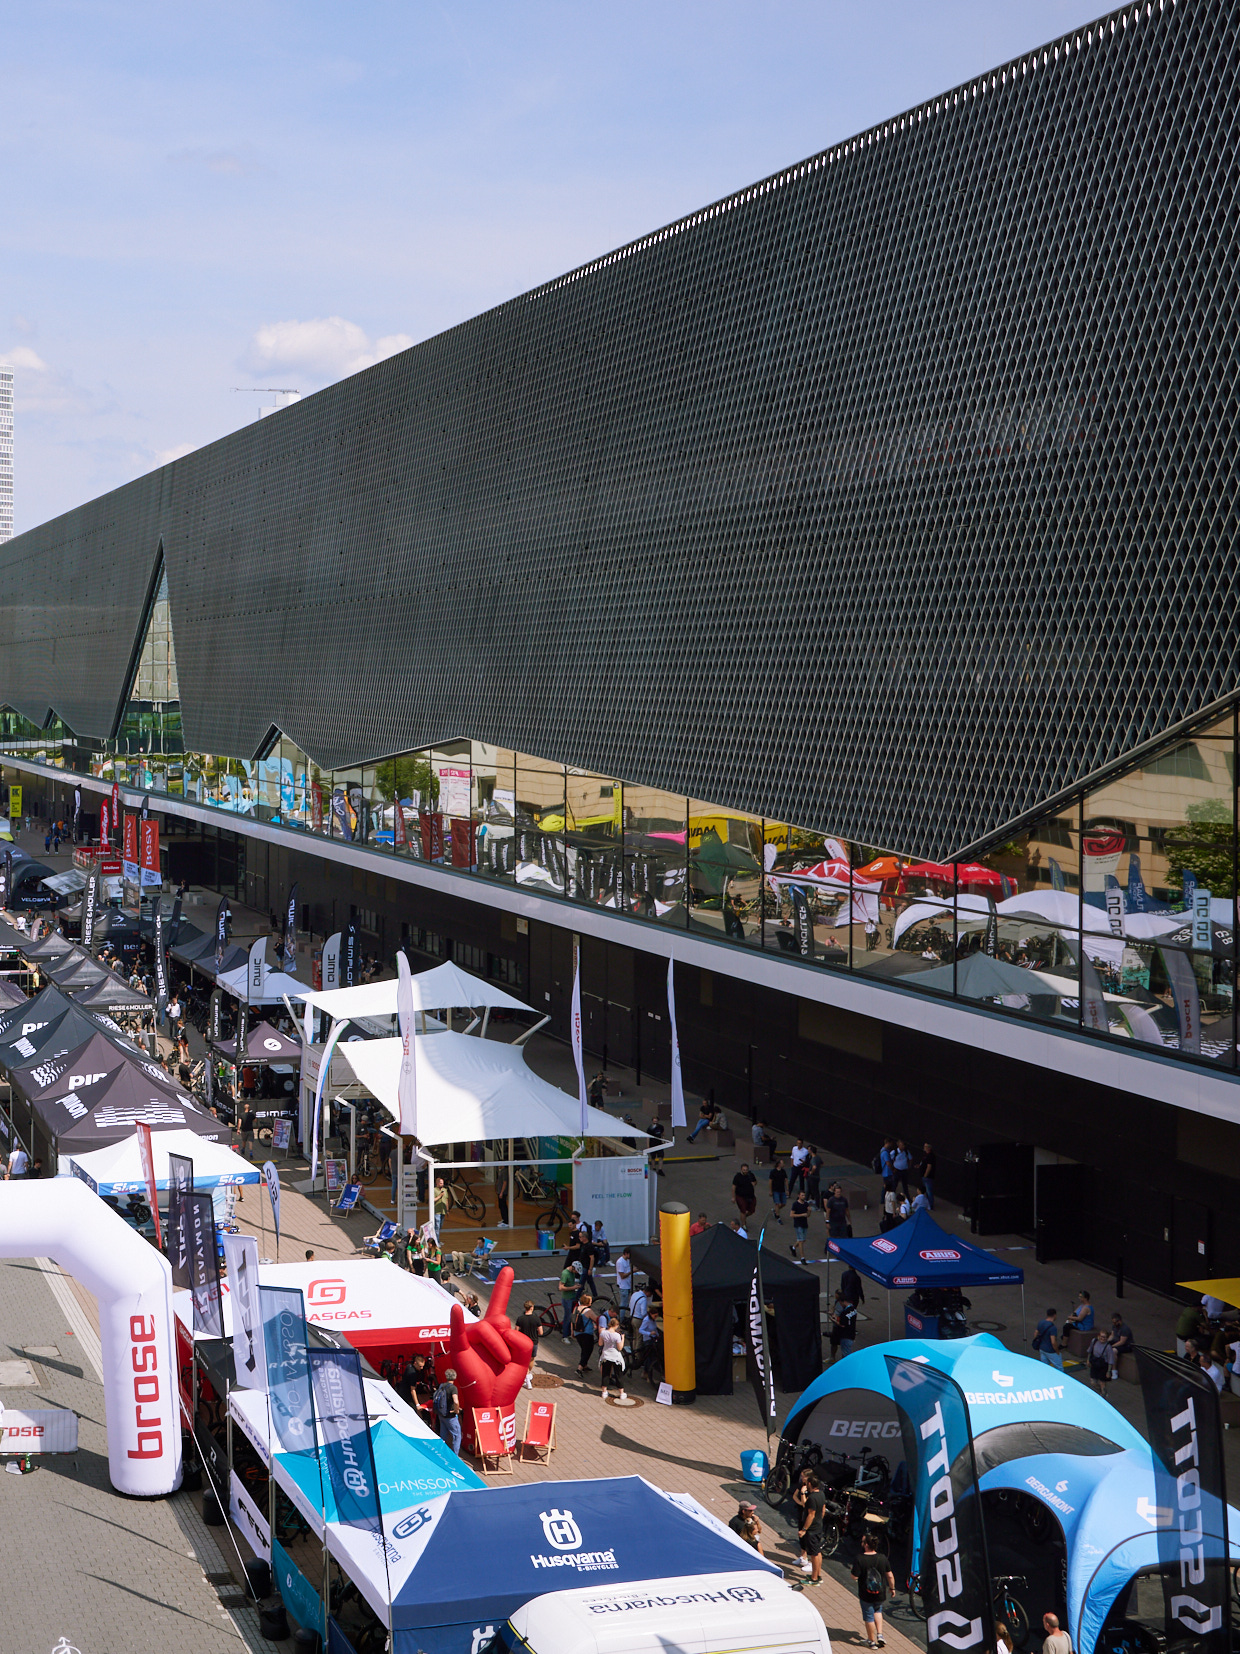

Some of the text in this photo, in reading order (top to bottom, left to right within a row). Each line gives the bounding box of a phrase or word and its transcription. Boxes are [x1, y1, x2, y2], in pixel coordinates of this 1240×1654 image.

[84, 916, 93, 945] RIESE
[218, 911, 226, 941] QWIC
[253, 958, 262, 987] QWIC
[327, 953, 336, 983] QWIC
[874, 1240, 897, 1252] ABUS
[922, 1251, 957, 1259] ABUS
[418, 1327, 451, 1339] GAS
[127, 1313, 162, 1460] brose
[964, 1385, 1065, 1405] BERGAMONT
[2, 1424, 45, 1438] rose
[1025, 1475, 1075, 1516] BERGAMONT
[237, 1497, 270, 1549] FELT
[530, 1549, 615, 1570] Husqvarna
[576, 1563, 620, 1572] E-BICYCLES
[589, 1589, 730, 1614] Husqvarna
